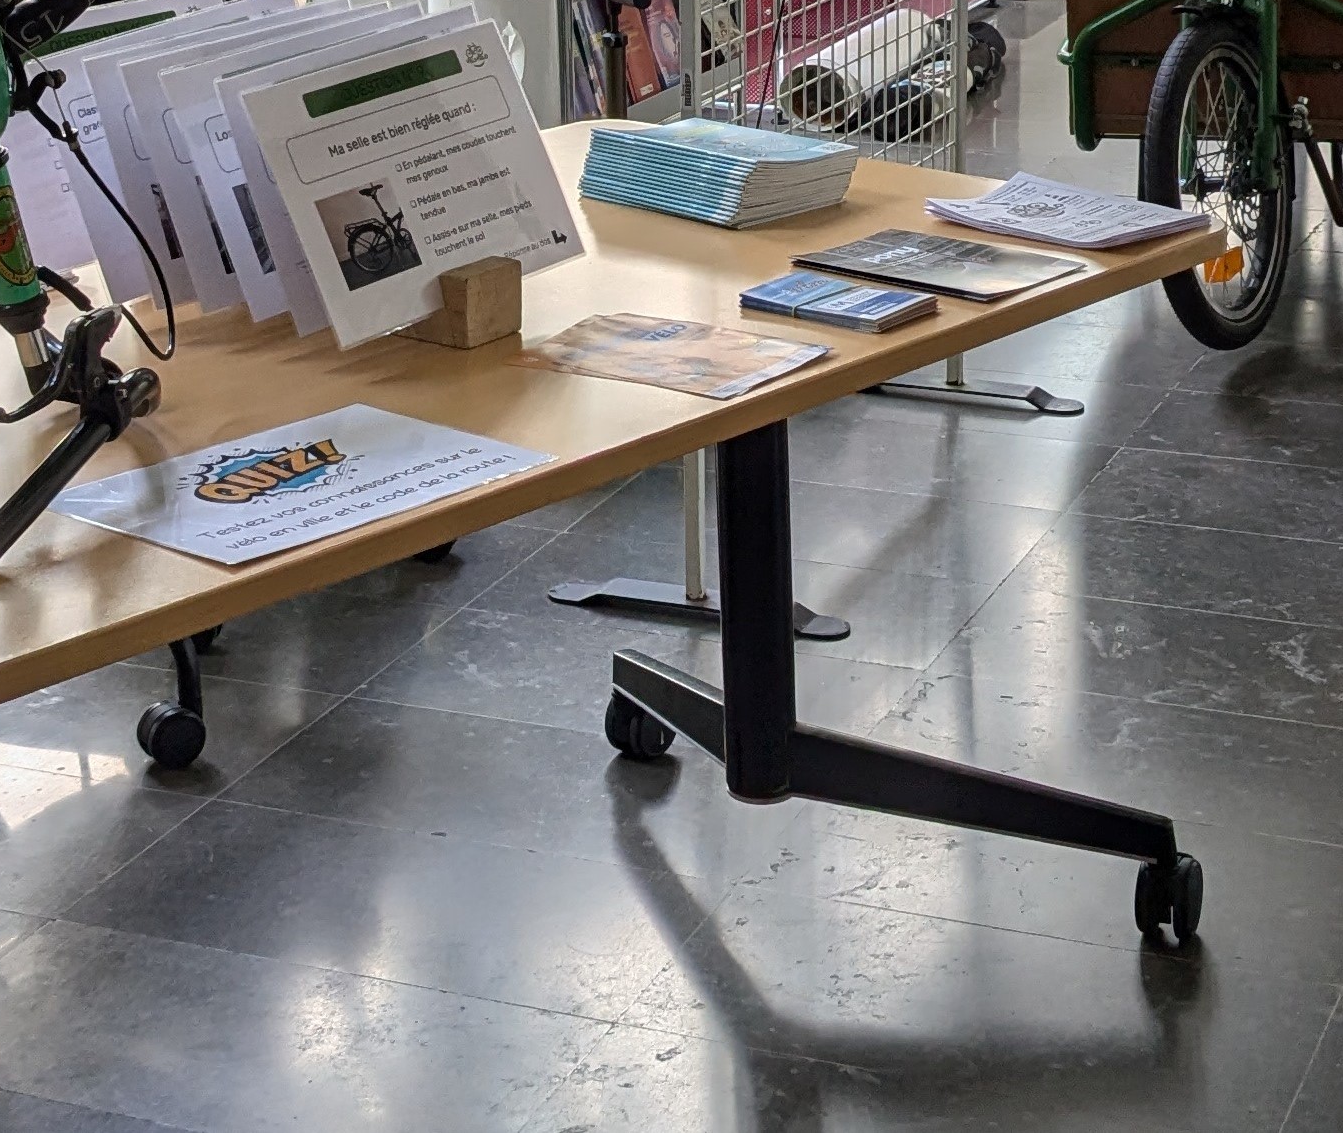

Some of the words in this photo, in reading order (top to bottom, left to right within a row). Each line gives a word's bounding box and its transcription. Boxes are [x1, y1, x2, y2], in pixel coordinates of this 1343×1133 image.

[20, 10, 65, 49] 15
[327, 144, 345, 158] Ma
[345, 136, 371, 152] selle
[371, 129, 388, 145] est
[388, 121, 411, 138] bien
[410, 113, 441, 134] réglée
[441, 102, 472, 123] quand
[445, 146, 462, 156] mes
[461, 137, 486, 151] coudes
[486, 125, 517, 142] touchent
[422, 165, 449, 182] genoux
[416, 192, 442, 206] Pédale
[420, 206, 447, 221] tendue
[434, 239, 468, 257] touchent
[196, 516, 273, 540] Testez
[271, 505, 307, 519] vos
[308, 462, 435, 508] connaissances
[435, 453, 462, 465] sur
[460, 446, 483, 456] le
[269, 526, 298, 538] en
[296, 514, 334, 529] ville
[334, 506, 357, 518] et
[351, 500, 375, 511] le
[375, 485, 419, 504] code
[418, 477, 445, 489] de
[438, 469, 463, 480] la
[459, 457, 506, 475] route
